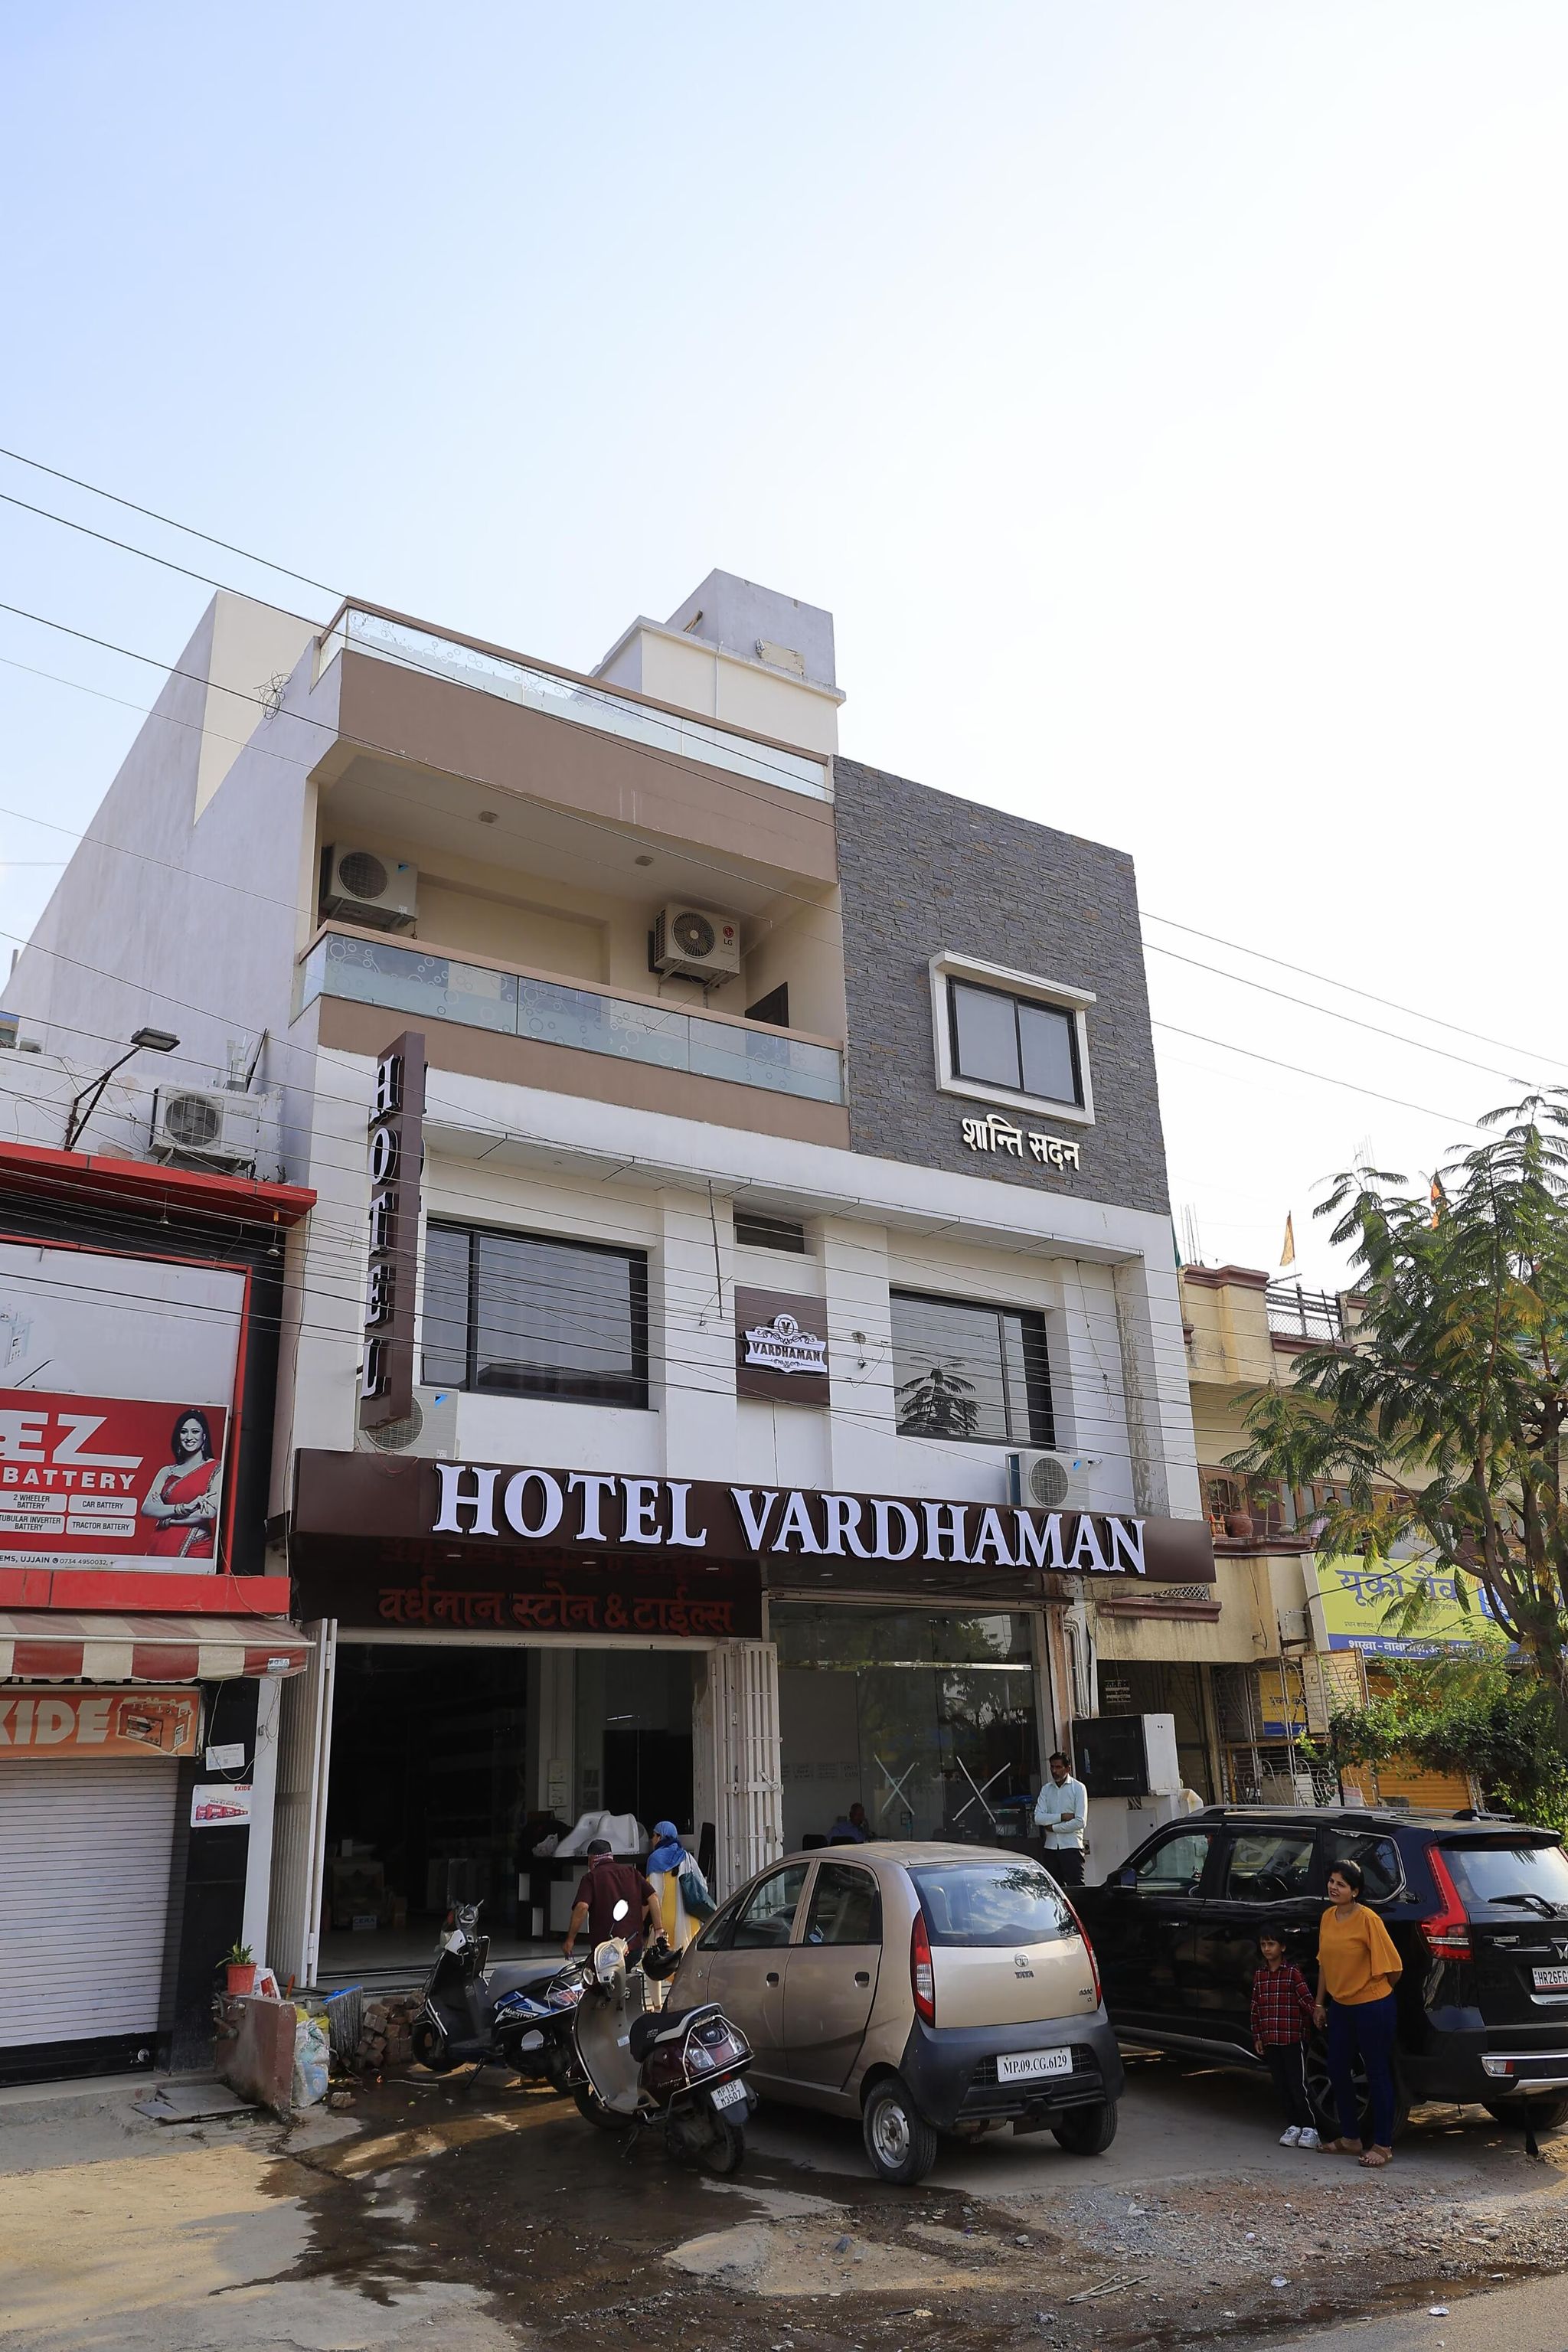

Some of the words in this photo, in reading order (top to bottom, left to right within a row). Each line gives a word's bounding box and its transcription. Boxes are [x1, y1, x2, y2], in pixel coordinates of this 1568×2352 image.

[724, 938, 733, 946] LG
[962, 1113, 1024, 1158] शान्ति
[1027, 1132, 1080, 1171] सदन
[360, 1054, 403, 1401] HOTEL
[752, 1342, 821, 1362] VARDHAMAN
[2, 1467, 136, 1490] BATTERY
[19, 1494, 50, 1502] WHEELER
[17, 1501, 45, 1510] BATTERY
[97, 1501, 123, 1510] BATTERY
[30, 1516, 60, 1524] INVERTER
[431, 1463, 707, 1547] HOTEL
[729, 1487, 1146, 1574] VARDHAMAN
[15, 1523, 43, 1531] BATTERY
[73, 1521, 101, 1530] TRACTOR
[103, 1522, 129, 1530] BATTERY
[21, 1556, 50, 1564] UJJAIN
[378, 1575, 506, 1626] वर्धमान
[511, 1580, 599, 1628] स्टोन
[603, 1592, 628, 1629] &
[632, 1585, 734, 1637] टाईल्स
[1014, 1970, 1034, 1979] TATA
[1003, 2054, 1067, 2075] MP.09.CG.6129
[717, 2082, 738, 2098] MP13F
[720, 2089, 742, 2106] M3507
